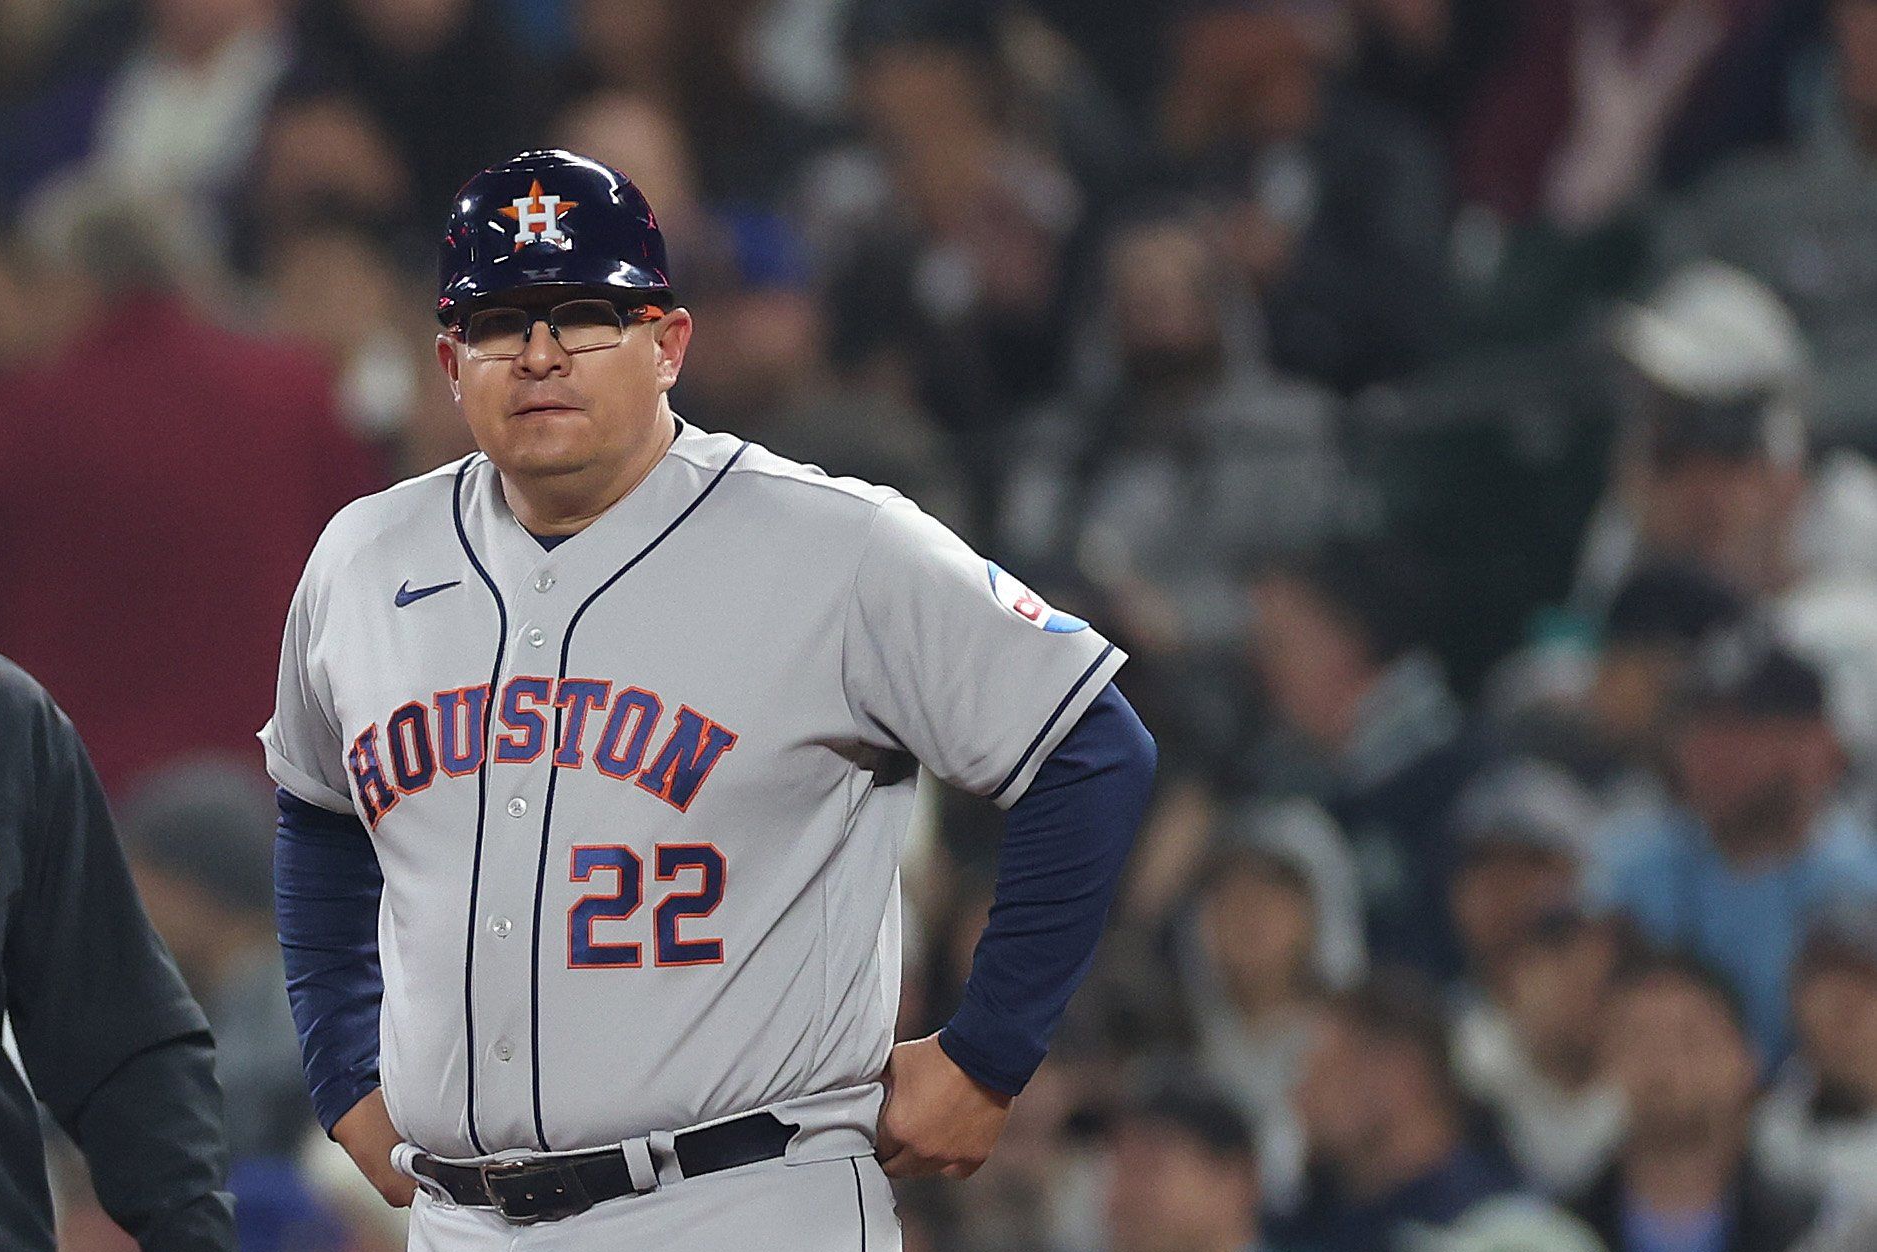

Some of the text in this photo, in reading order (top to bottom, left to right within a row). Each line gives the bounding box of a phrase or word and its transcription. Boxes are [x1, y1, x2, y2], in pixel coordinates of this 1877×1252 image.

[513, 195, 564, 242] H
[349, 675, 738, 831] HOUSTON
[567, 842, 727, 969] 22
